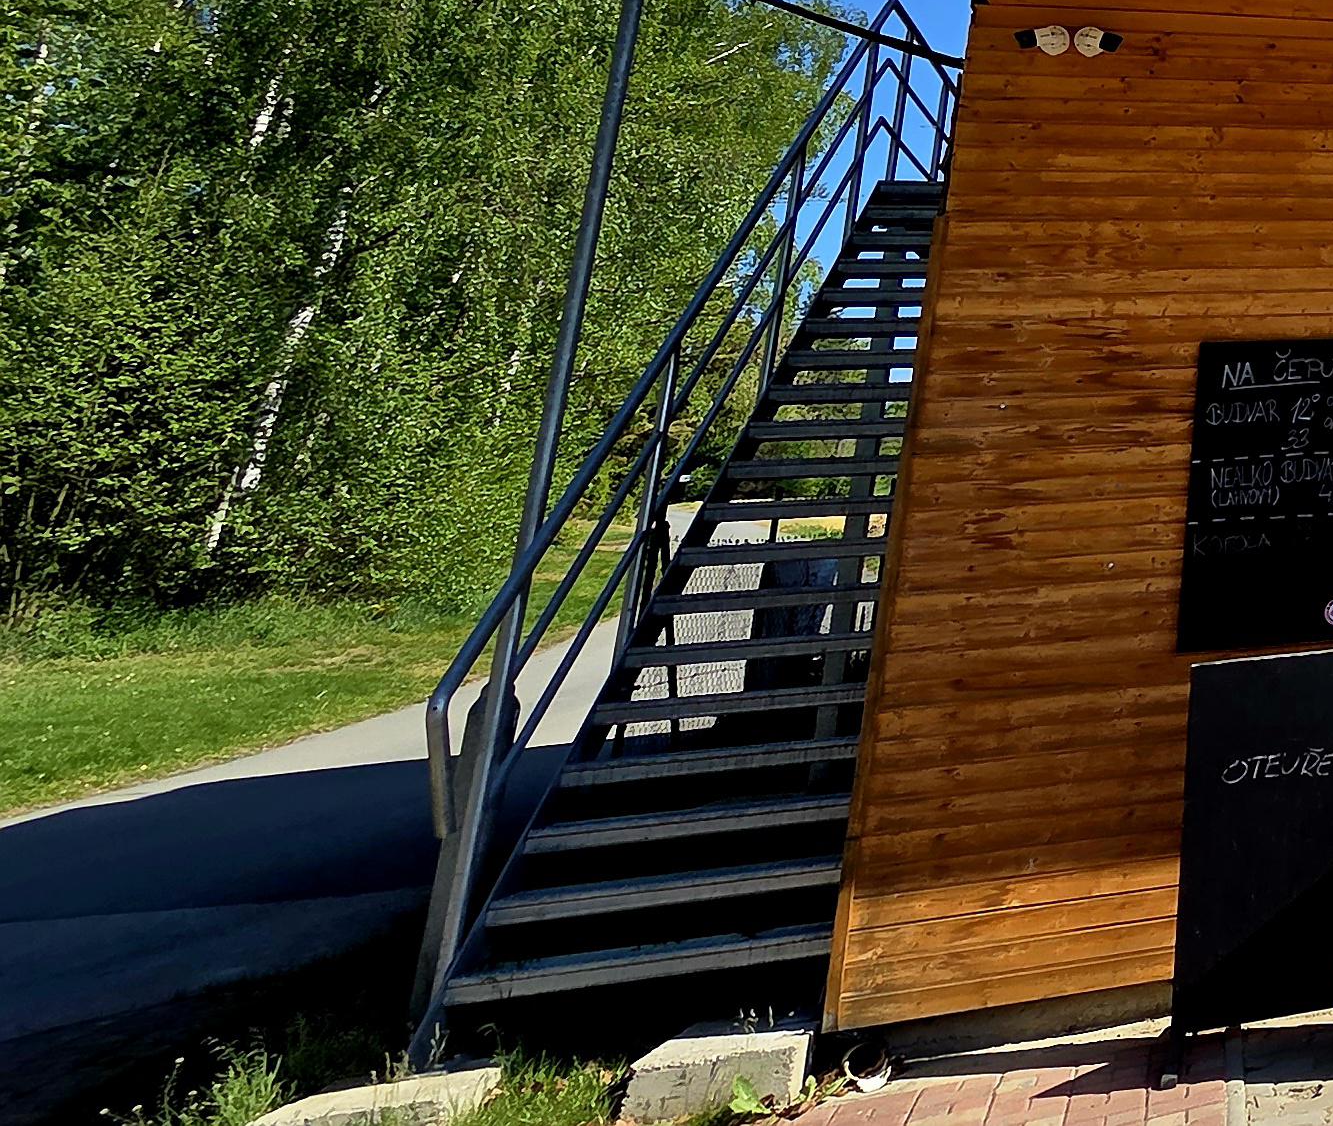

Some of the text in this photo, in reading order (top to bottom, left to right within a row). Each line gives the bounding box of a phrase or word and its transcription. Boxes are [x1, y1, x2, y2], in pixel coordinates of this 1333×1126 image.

[1221, 362, 1255, 389] NA
[1205, 399, 1280, 425] BUDVAR
[1211, 460, 1273, 489] NEALKO
